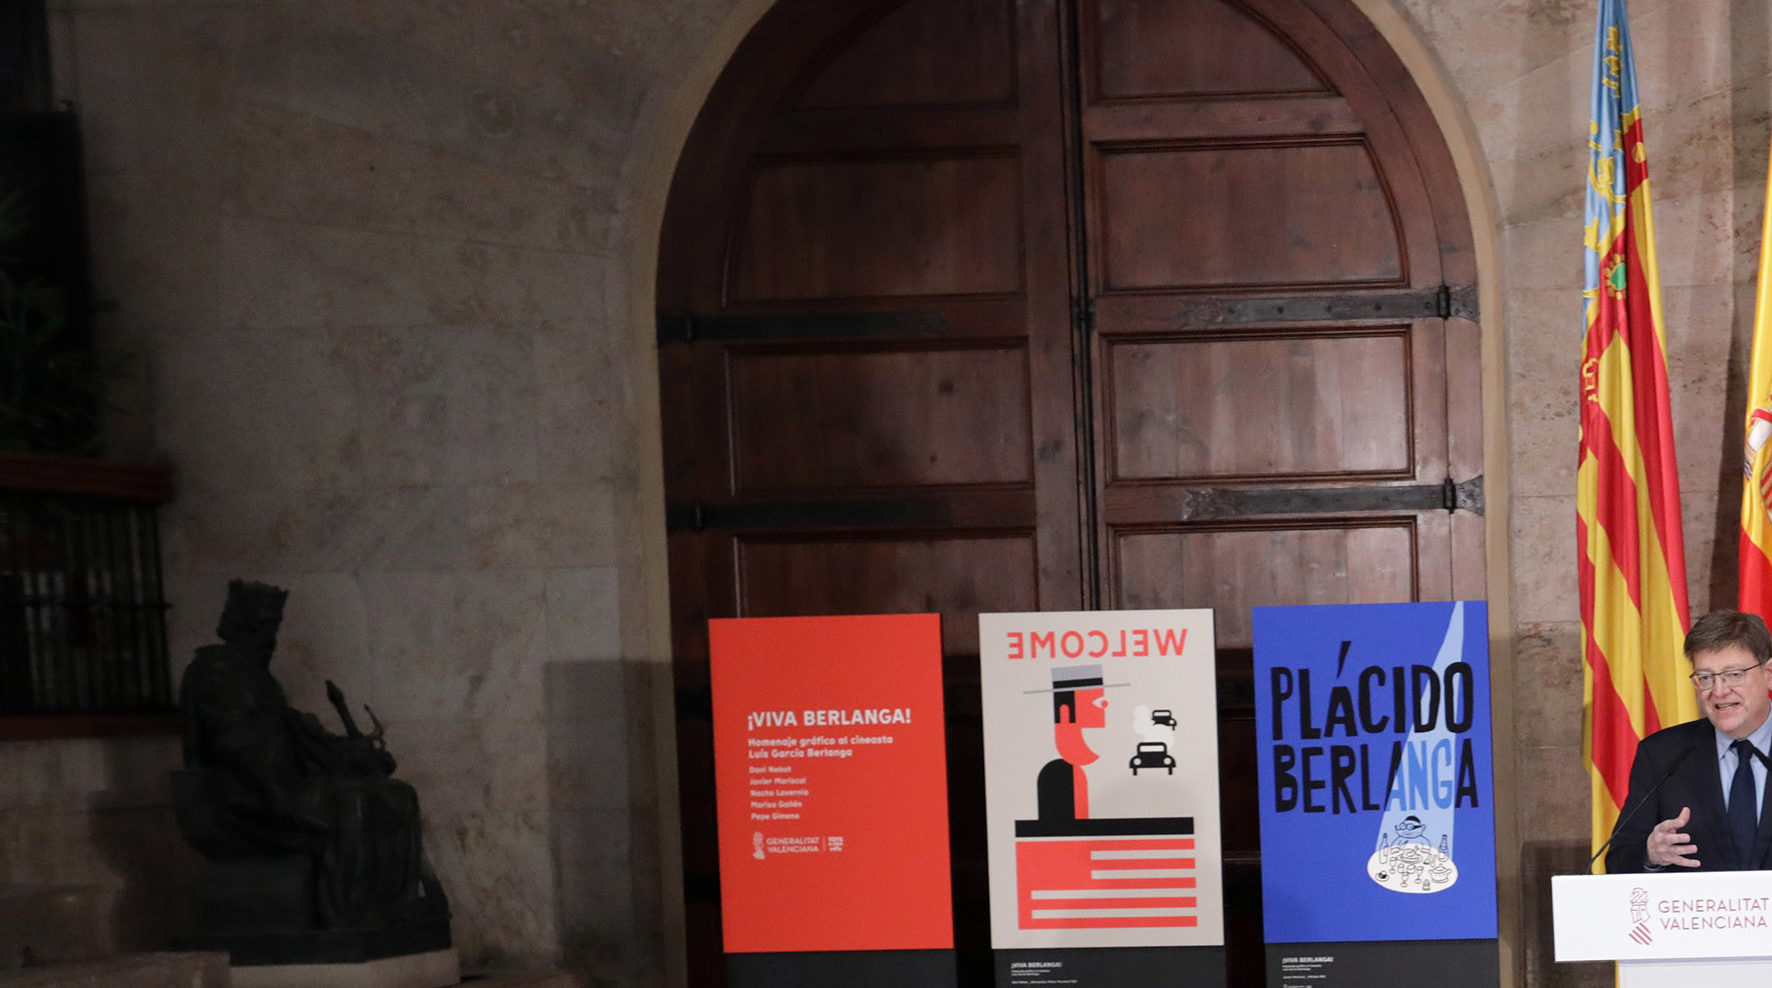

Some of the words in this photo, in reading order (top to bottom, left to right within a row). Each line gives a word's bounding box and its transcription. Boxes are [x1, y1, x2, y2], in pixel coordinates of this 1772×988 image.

[1271, 641, 1474, 741] PLÁCIDO
[747, 710, 798, 731] ¡VIVA
[803, 708, 912, 727] BERLANGA!
[748, 736, 797, 748] Homenaje
[800, 735, 836, 748] gráfico
[838, 736, 848, 744] al
[850, 734, 894, 745] cineasta
[771, 748, 805, 759] García
[807, 747, 853, 759] Berlanga
[1274, 738, 1479, 815] BERLANGA
[766, 836, 820, 845] GENERALITAT
[767, 845, 819, 853] VALENCIANA
[1657, 897, 1769, 913] GENERALITAT
[1660, 915, 1768, 930] VALENCIANA
